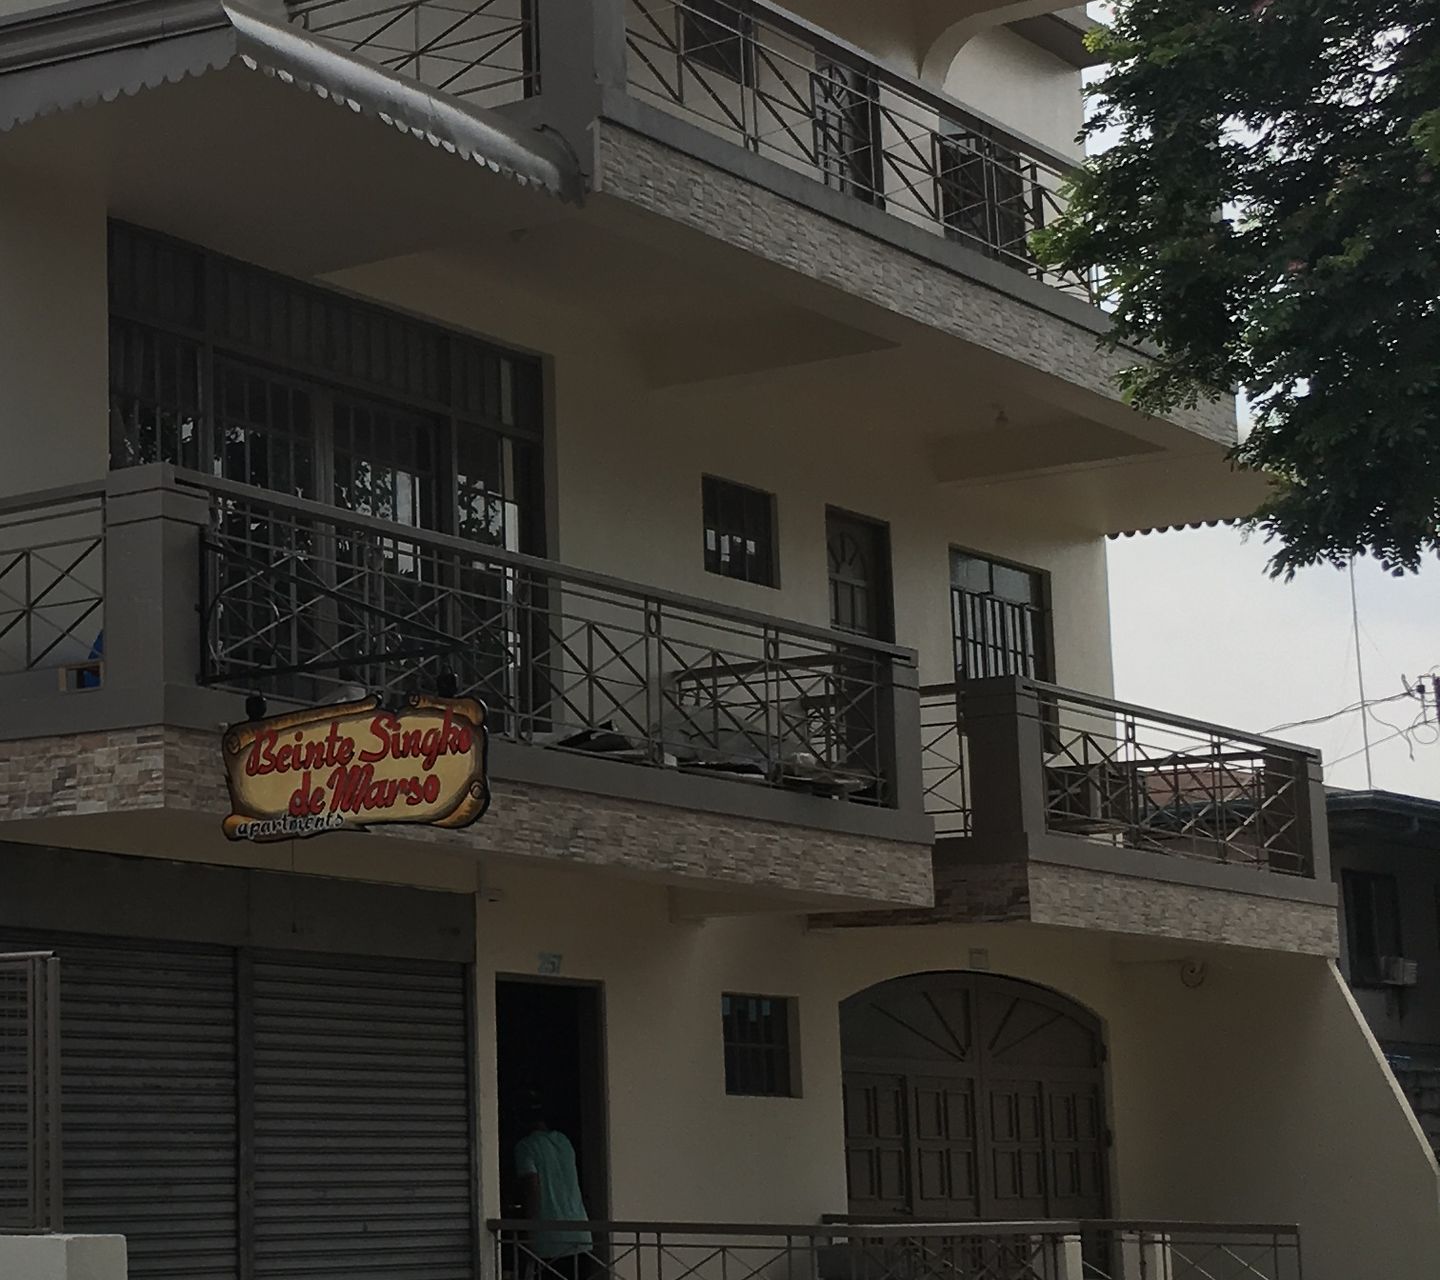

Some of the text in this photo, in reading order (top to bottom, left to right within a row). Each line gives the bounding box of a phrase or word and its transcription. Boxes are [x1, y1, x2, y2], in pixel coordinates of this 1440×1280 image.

[246, 709, 473, 776] Beinte Singko
[288, 764, 441, 817] de Marso
[235, 812, 345, 840] apartments
